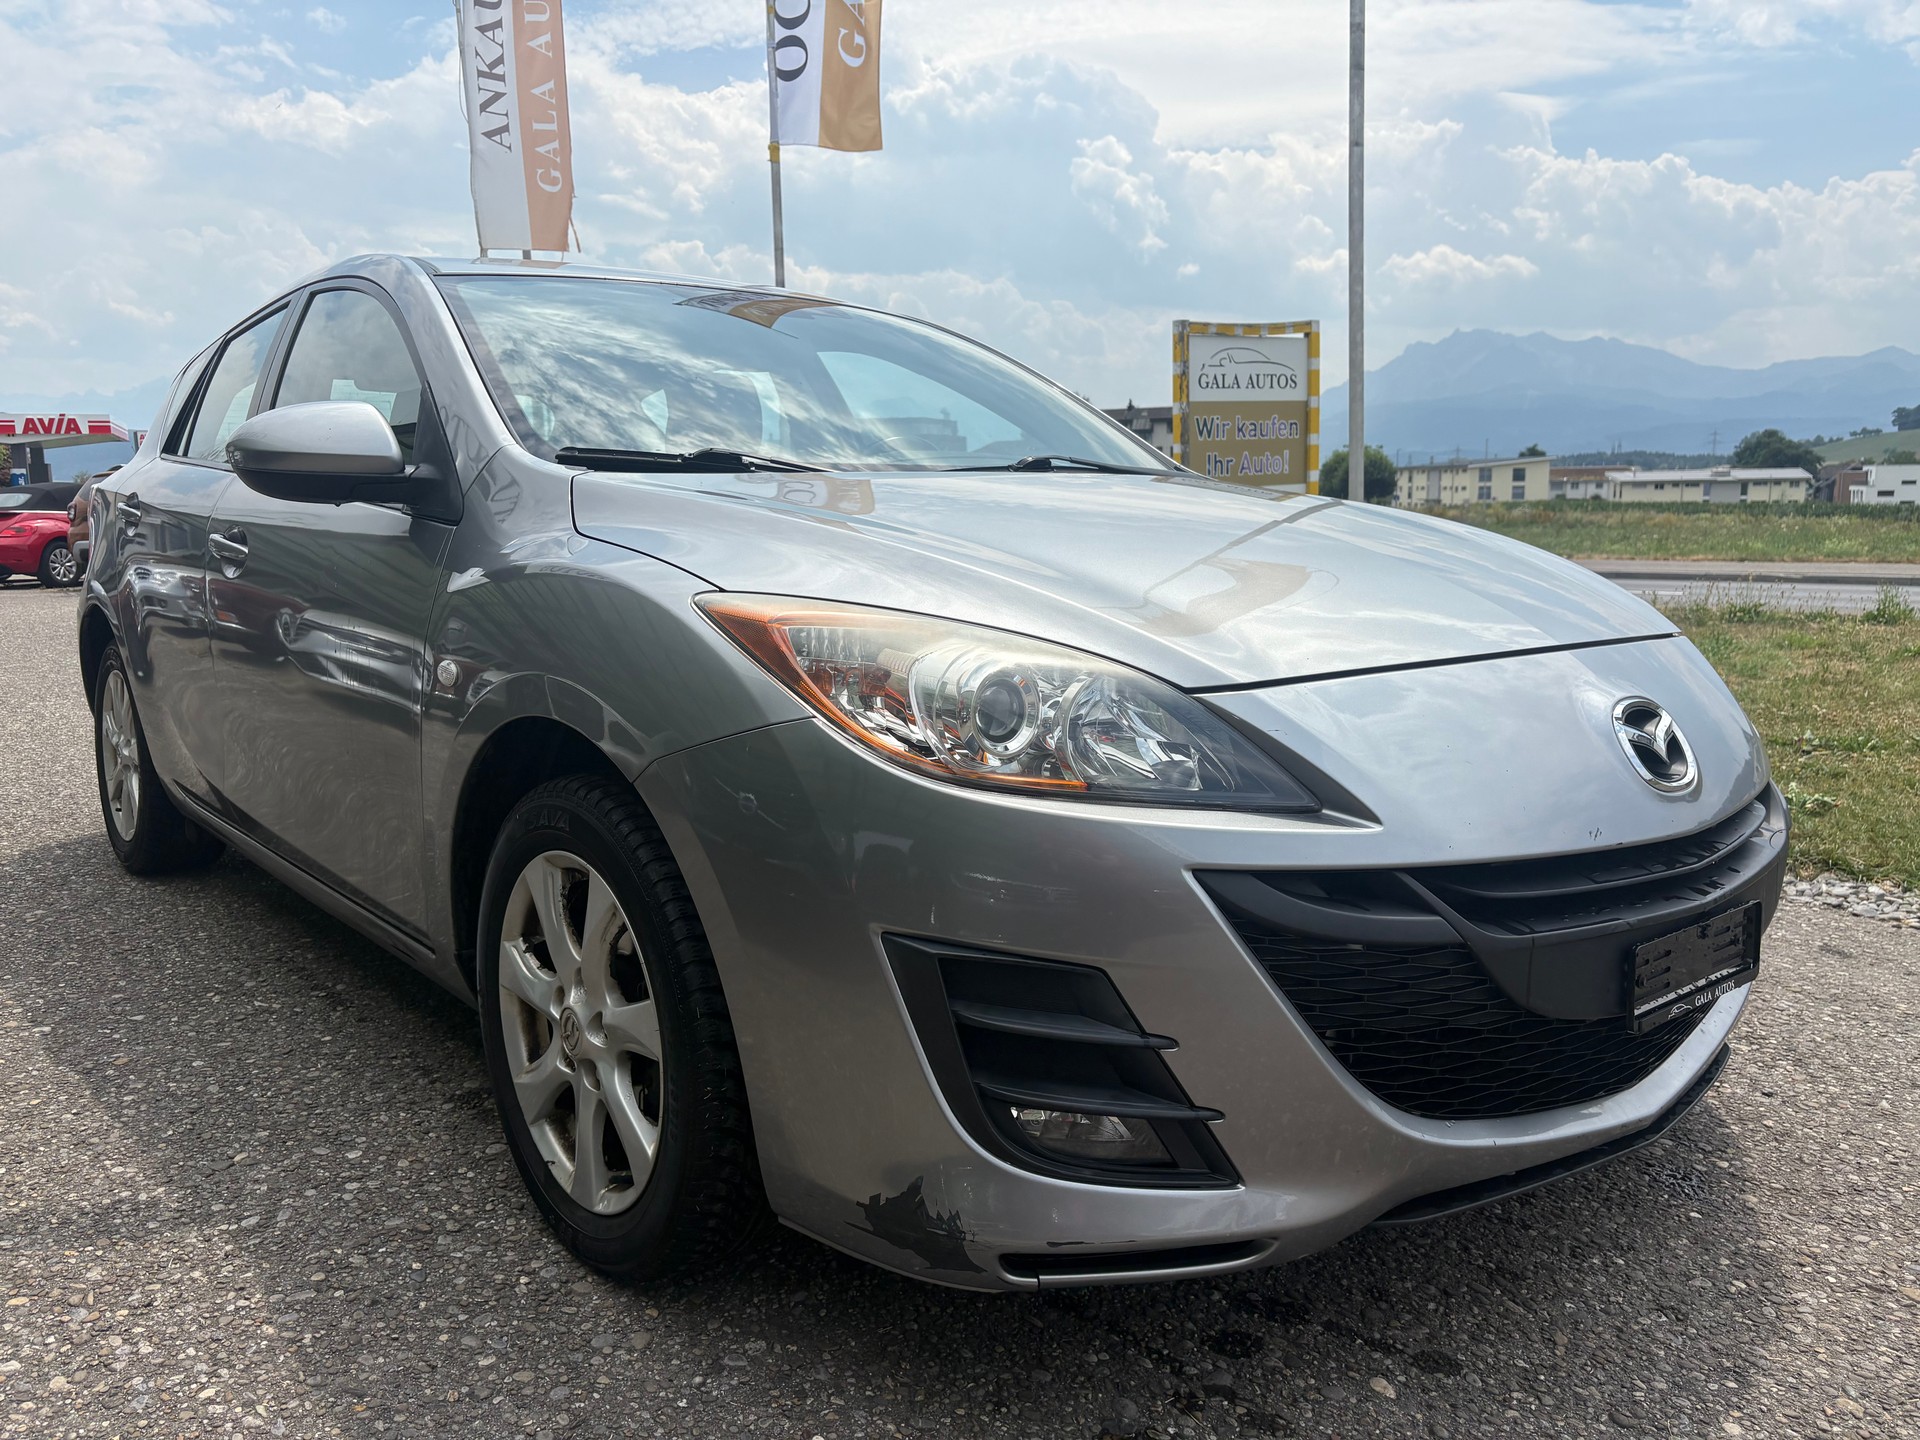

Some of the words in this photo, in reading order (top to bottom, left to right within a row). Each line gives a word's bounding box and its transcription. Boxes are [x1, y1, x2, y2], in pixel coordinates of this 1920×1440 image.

[524, 0, 552, 58] AU
[530, 80, 562, 193] GALA
[1198, 373, 1241, 389] GALA
[1245, 373, 1297, 389] AUTOS
[1194, 416, 1231, 441] Wir
[1235, 414, 1299, 439] kaufen
[1206, 452, 1235, 477] Ihr
[1238, 450, 1289, 475] Auto!
[1695, 991, 1712, 1006] GALA
[1714, 980, 1735, 998] AUTOS
